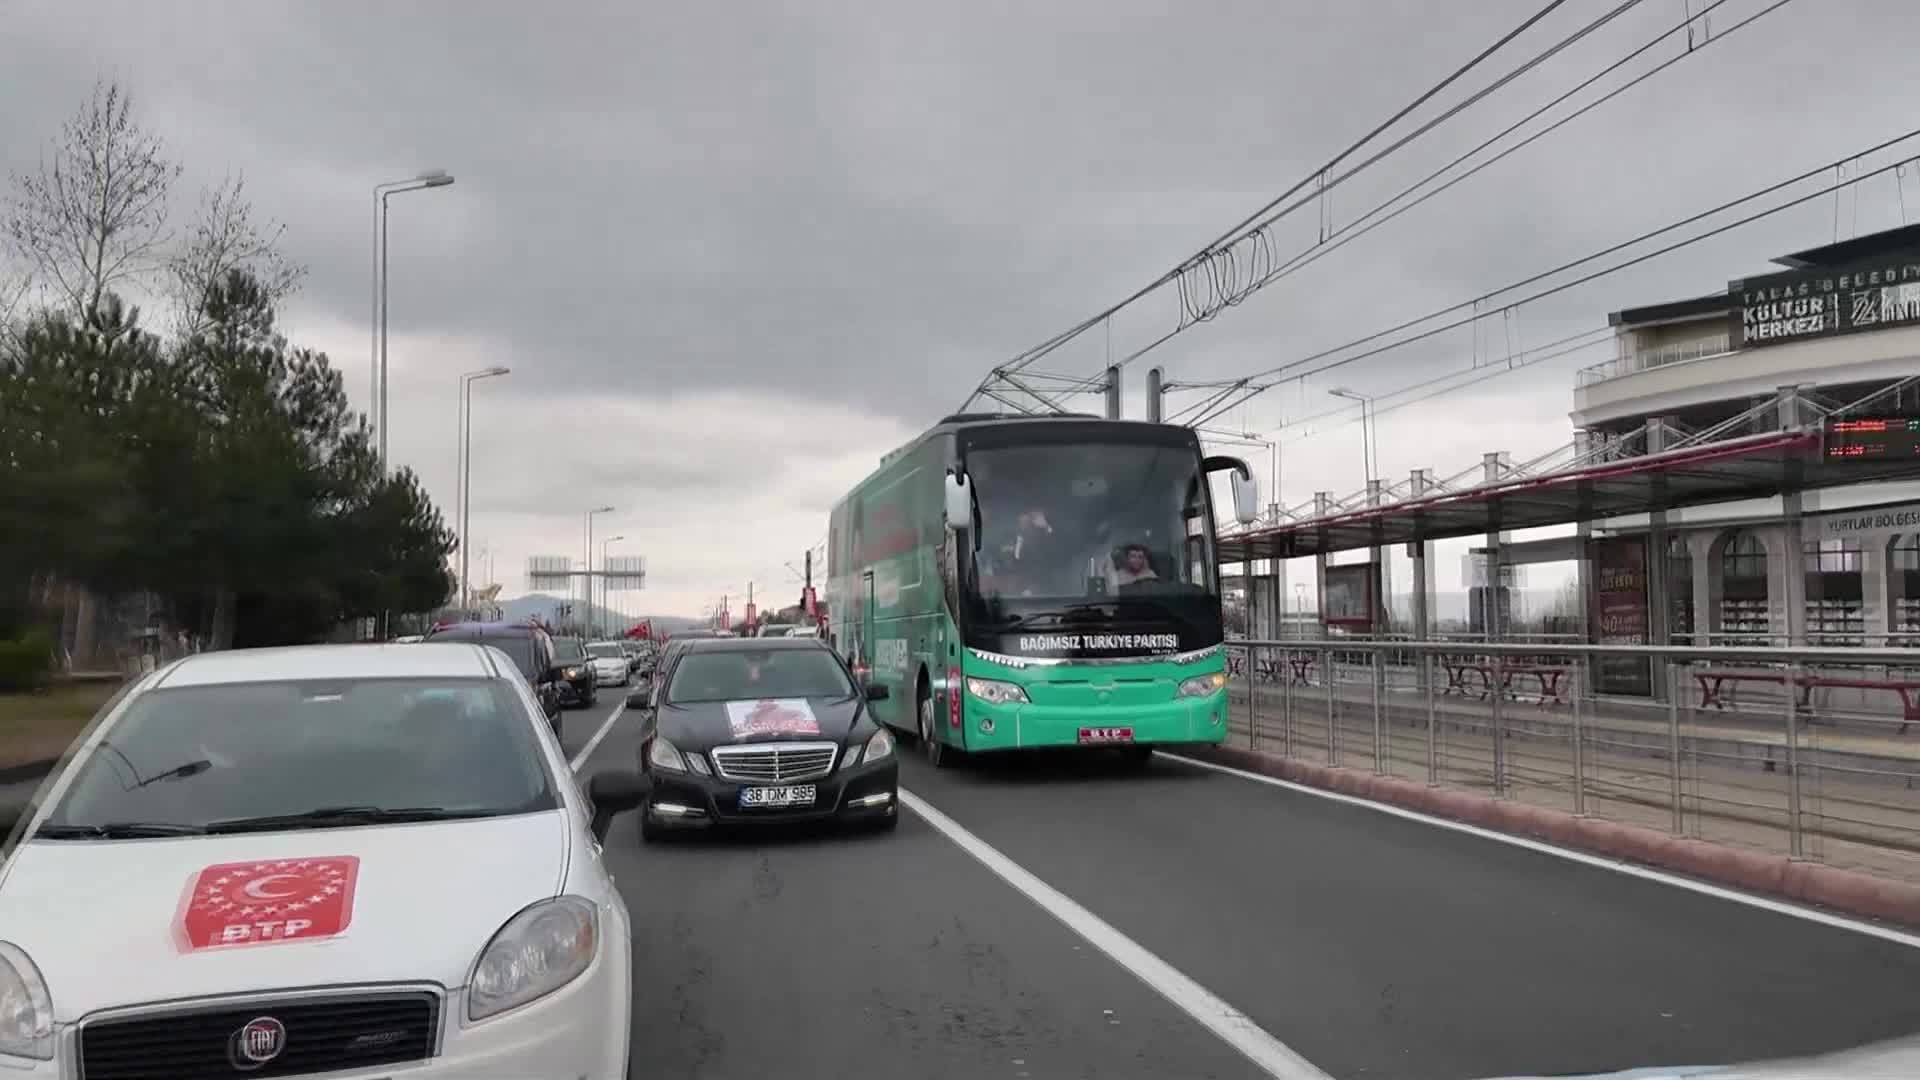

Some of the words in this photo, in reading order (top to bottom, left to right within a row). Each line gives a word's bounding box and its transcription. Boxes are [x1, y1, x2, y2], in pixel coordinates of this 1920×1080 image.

[1744, 298, 1824, 324] KÜLTÜR
[1020, 635, 1081, 650] BAĞIMSIZ
[222, 919, 311, 941] BTP
[250, 1029, 278, 1052] FIAT
